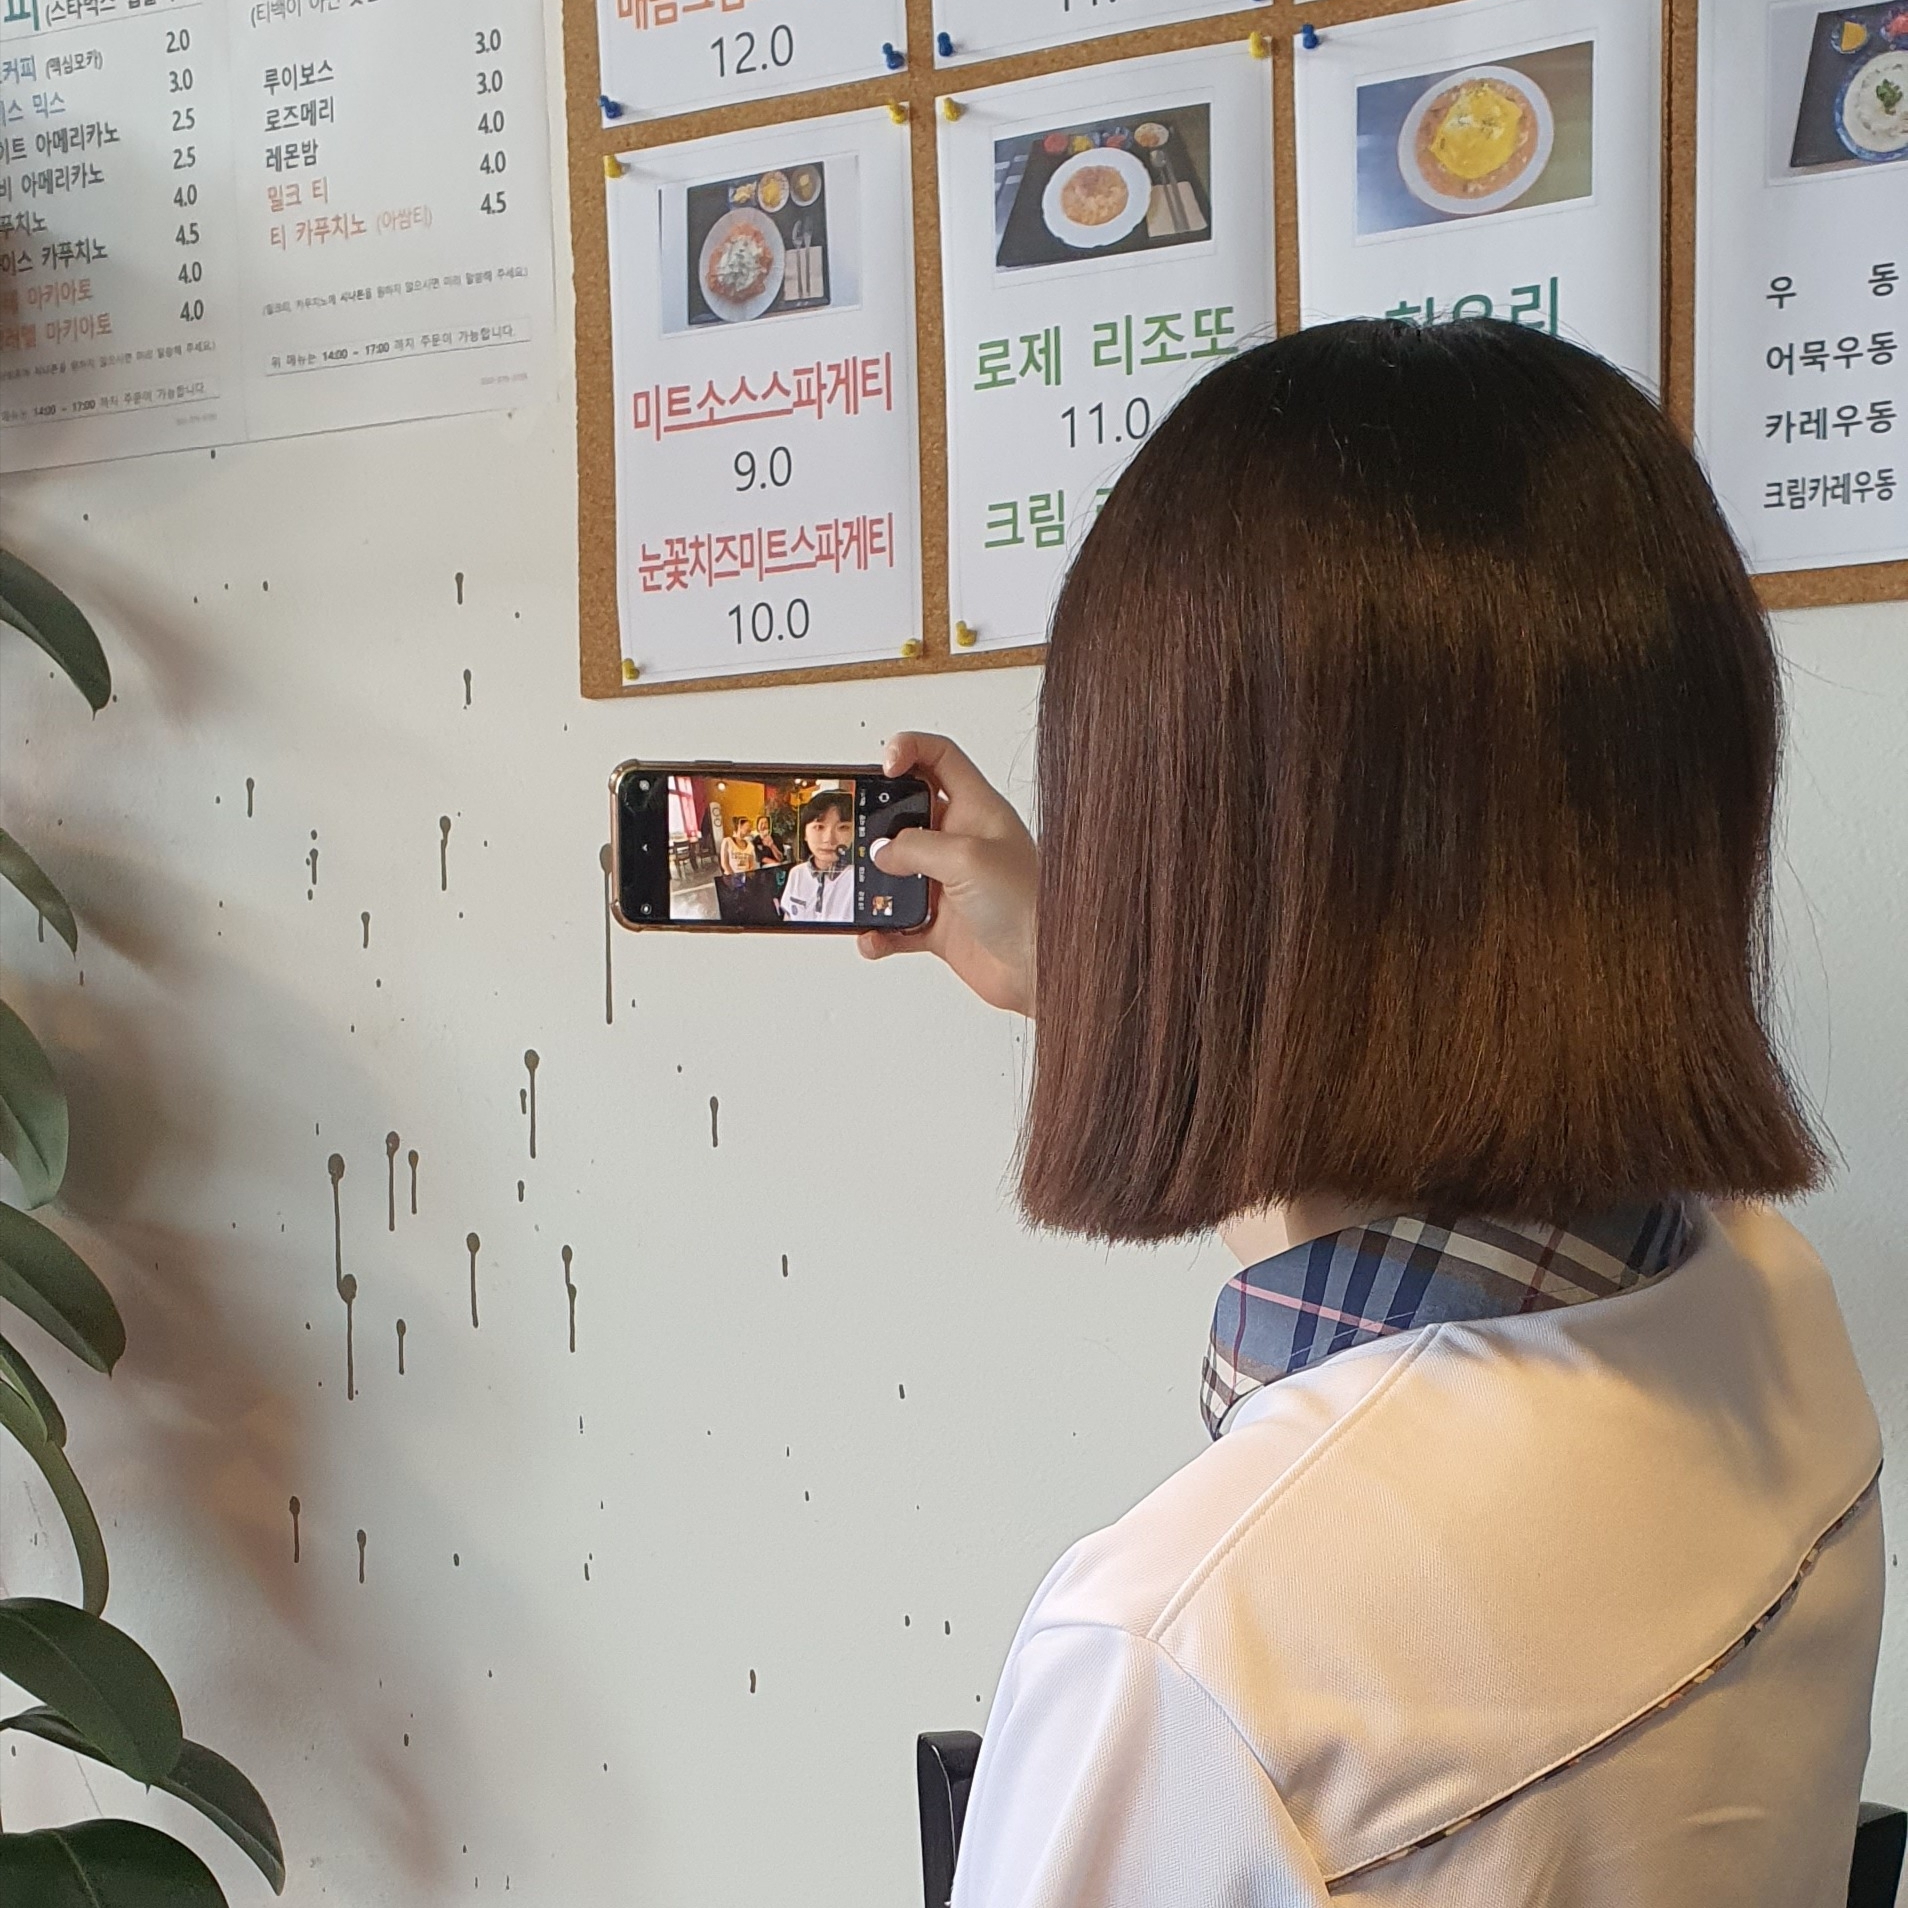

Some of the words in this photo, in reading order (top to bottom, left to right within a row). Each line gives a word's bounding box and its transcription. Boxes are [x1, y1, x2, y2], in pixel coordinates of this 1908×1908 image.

[166, 29, 190, 53] 2.0
[475, 29, 502, 54] 3.0
[710, 24, 794, 78] 12.0
[0, 54, 36, 84] 커피
[169, 68, 194, 93] 3.0
[263, 60, 335, 96] 루이보스
[476, 70, 503, 95] 3.0
[32, 91, 66, 119] 믹스
[172, 107, 196, 132] 2.5
[264, 96, 335, 132] 로즈메리
[477, 110, 504, 135] 4.0
[35, 121, 121, 157] 아메리카노
[266, 138, 319, 173] 레몬밤
[173, 146, 196, 170] 2.5
[479, 150, 506, 175] 4.0
[21, 161, 105, 198] 아메리카노
[173, 184, 198, 208] 4.0
[267, 184, 302, 213] 밀크
[312, 177, 329, 204] 티
[480, 191, 507, 215] 4.5
[175, 222, 200, 245] 4.5
[270, 224, 287, 250] 티
[296, 213, 367, 247] 카푸치노
[0, 250, 33, 276] 이스
[42, 236, 108, 270] 카푸치노
[178, 261, 202, 284] 4.0
[28, 278, 93, 310] 마키아토
[1766, 276, 1797, 309] 우
[1868, 262, 1899, 297] 동
[180, 299, 204, 322] 4.0
[974, 325, 1061, 390] 로제
[1093, 306, 1239, 376] 리조또
[1766, 331, 1898, 376] 어묵우동
[633, 352, 892, 441] 미트소스스파게티
[1061, 397, 1151, 448] 11.0
[1765, 400, 1897, 443] 카레우동
[734, 446, 792, 492] 9.0
[1763, 468, 1897, 510] 크림카레우동
[984, 490, 1065, 549] 크림
[638, 512, 893, 592] 눈꽃치즈미트스파게티
[728, 598, 810, 645] 10.0
